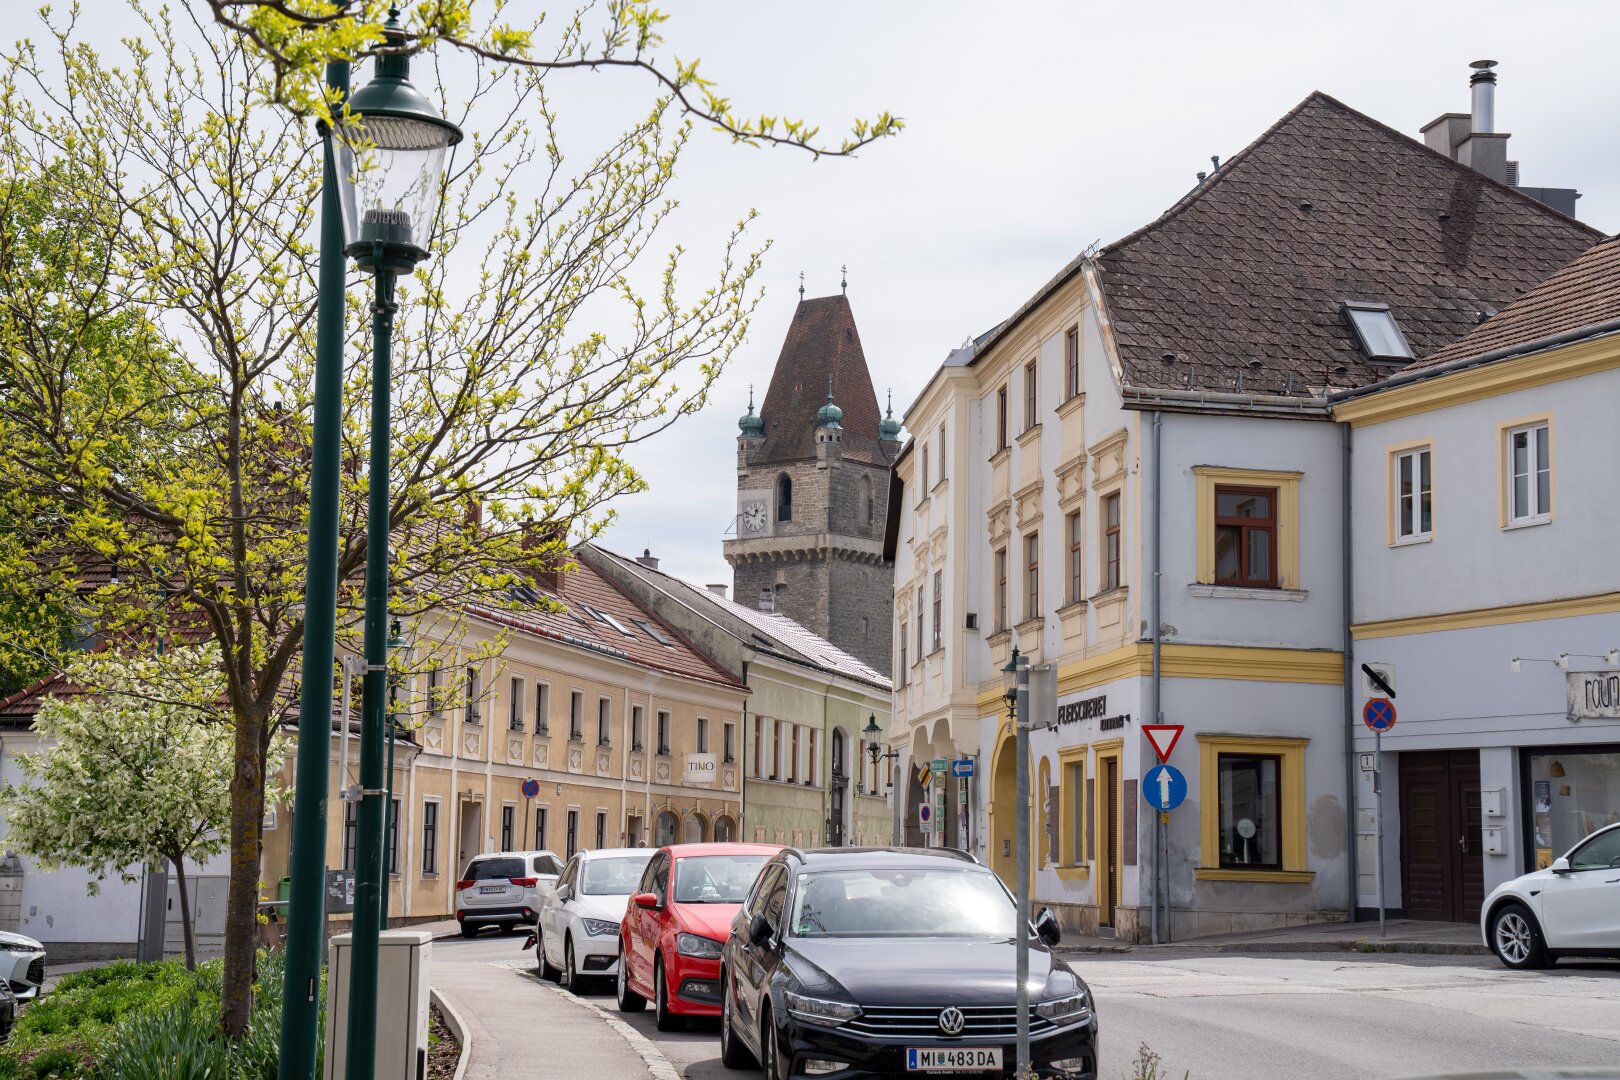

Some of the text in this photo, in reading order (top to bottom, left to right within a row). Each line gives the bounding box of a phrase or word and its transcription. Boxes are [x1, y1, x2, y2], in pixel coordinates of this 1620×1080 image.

[1585, 675, 1620, 709] raum
[1058, 694, 1107, 725] FLEISCHEREI
[688, 761, 714, 771] TINO
[940, 1007, 965, 1034] VW
[921, 1051, 935, 1066] MI
